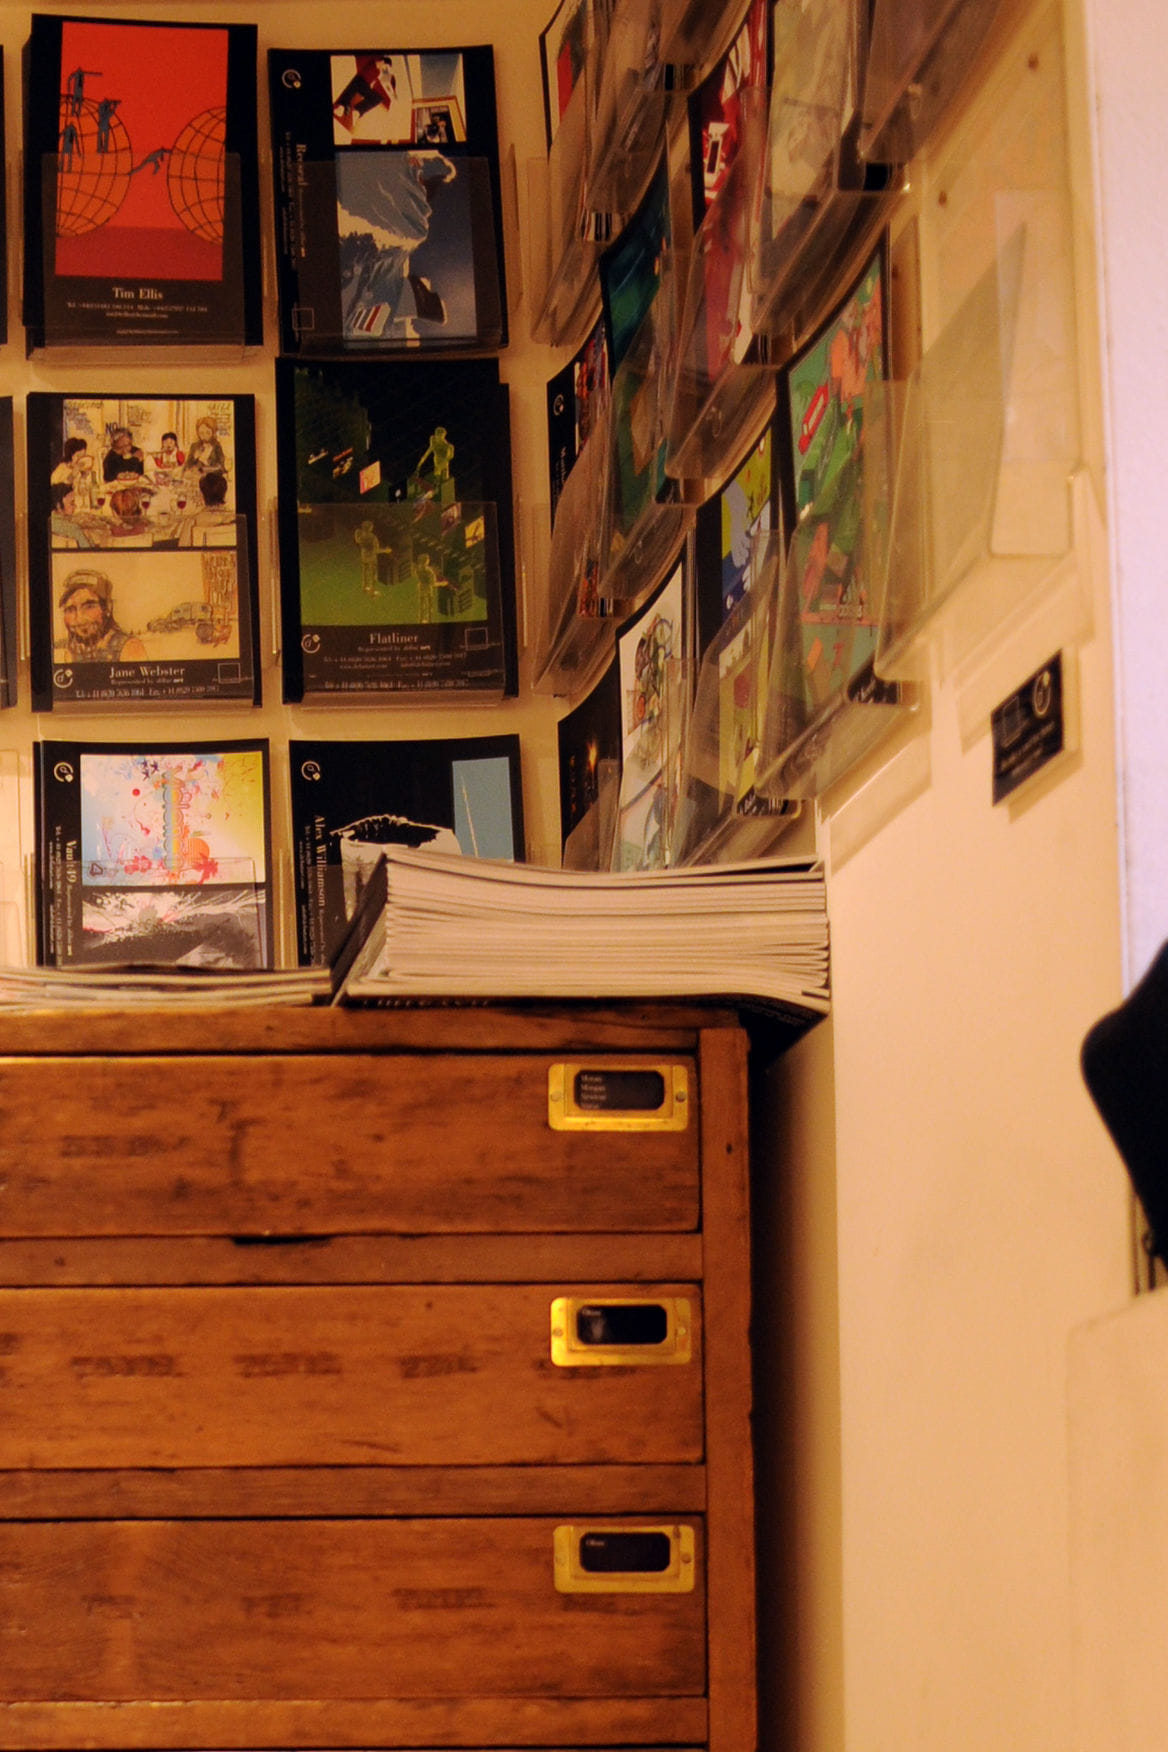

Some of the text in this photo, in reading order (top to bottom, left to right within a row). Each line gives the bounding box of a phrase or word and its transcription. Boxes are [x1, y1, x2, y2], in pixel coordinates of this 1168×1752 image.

[113, 287, 163, 300] Tim Ellis
[370, 633, 418, 644] Flatliner
[109, 665, 185, 678] Jane Webster
[314, 815, 327, 907] Alex Williamson
